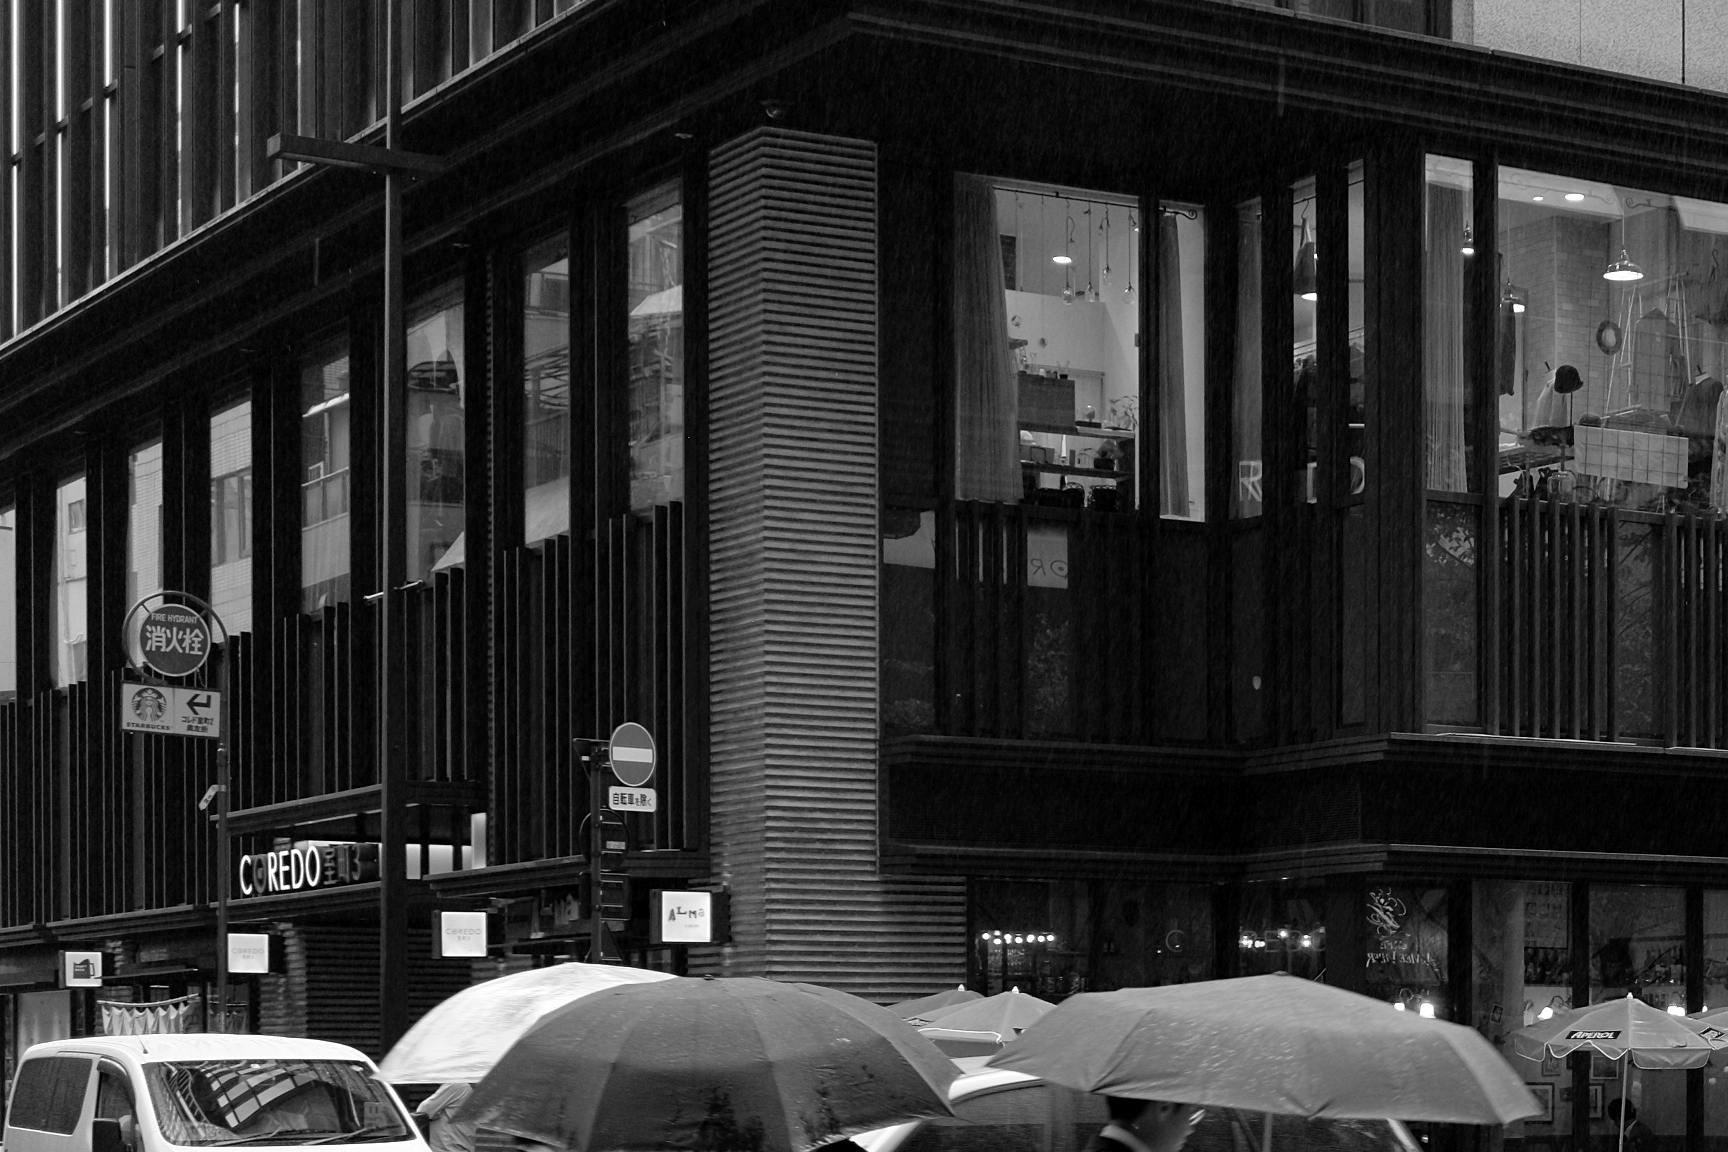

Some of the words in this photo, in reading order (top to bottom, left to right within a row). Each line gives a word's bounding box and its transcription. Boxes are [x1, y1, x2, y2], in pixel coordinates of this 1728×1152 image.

[152, 613, 166, 621] FIRE
[168, 614, 197, 624] HYDRANT
[146, 625, 204, 655] 消火栓
[613, 793, 651, 806] 自転車を除く
[240, 846, 320, 895] COREDO
[1571, 1031, 1614, 1039] APEROL
